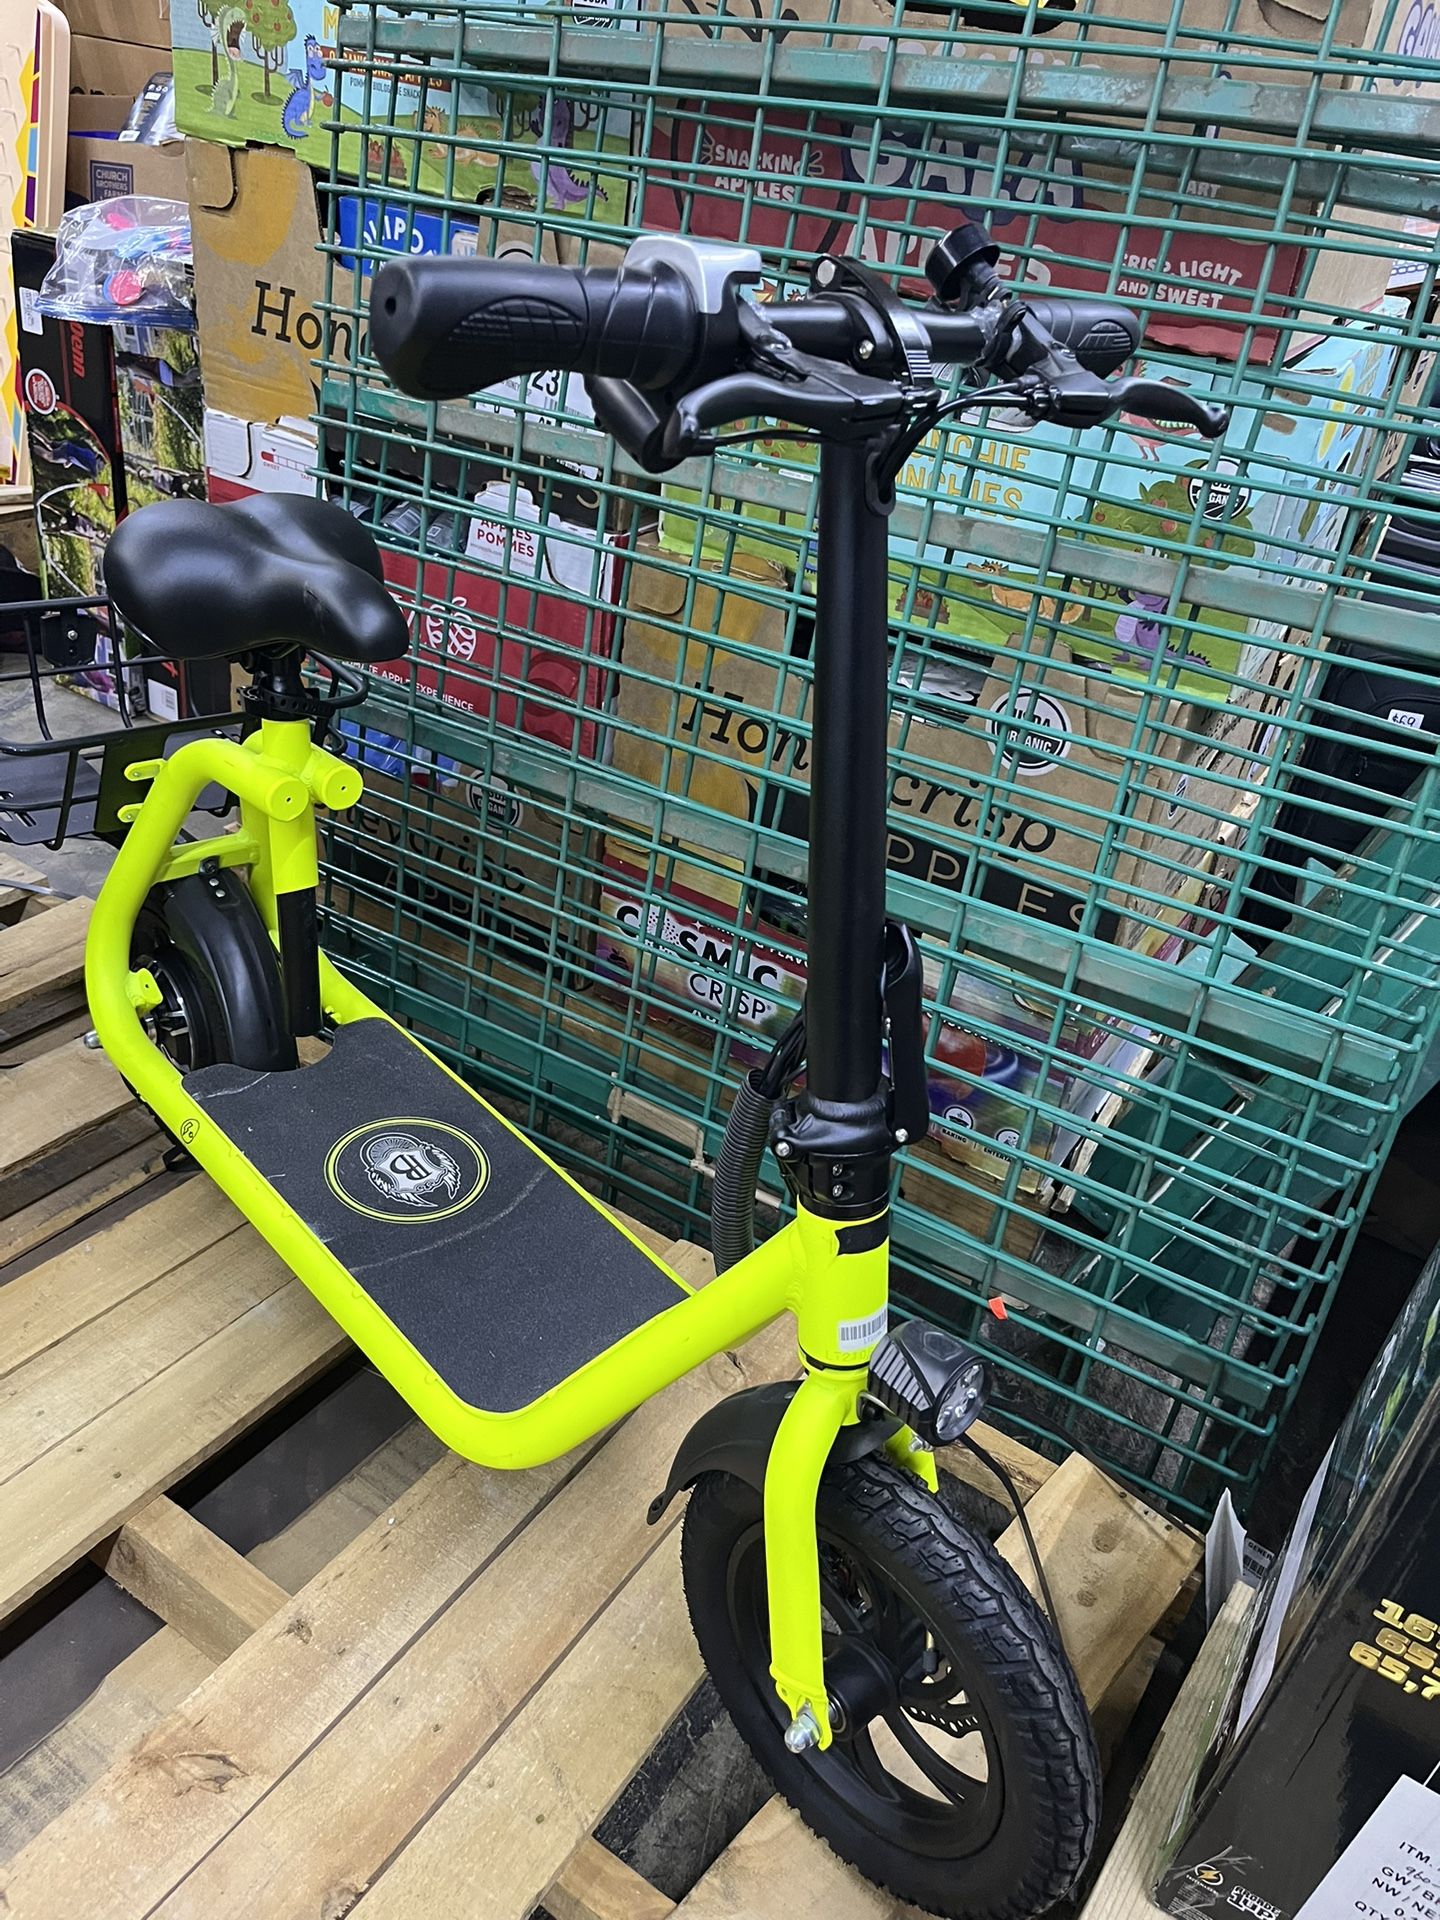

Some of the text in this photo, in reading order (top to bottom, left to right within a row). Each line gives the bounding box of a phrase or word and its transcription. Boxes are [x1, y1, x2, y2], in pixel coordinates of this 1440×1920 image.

[95, 169, 129, 182] CHURCH
[1180, 260, 1243, 287] LIGHT
[1117, 280, 1224, 309] AND SWEET
[941, 1127, 968, 1144] BAKING
[1381, 1866, 1412, 1886] GW
[1371, 1877, 1402, 1897] NW
